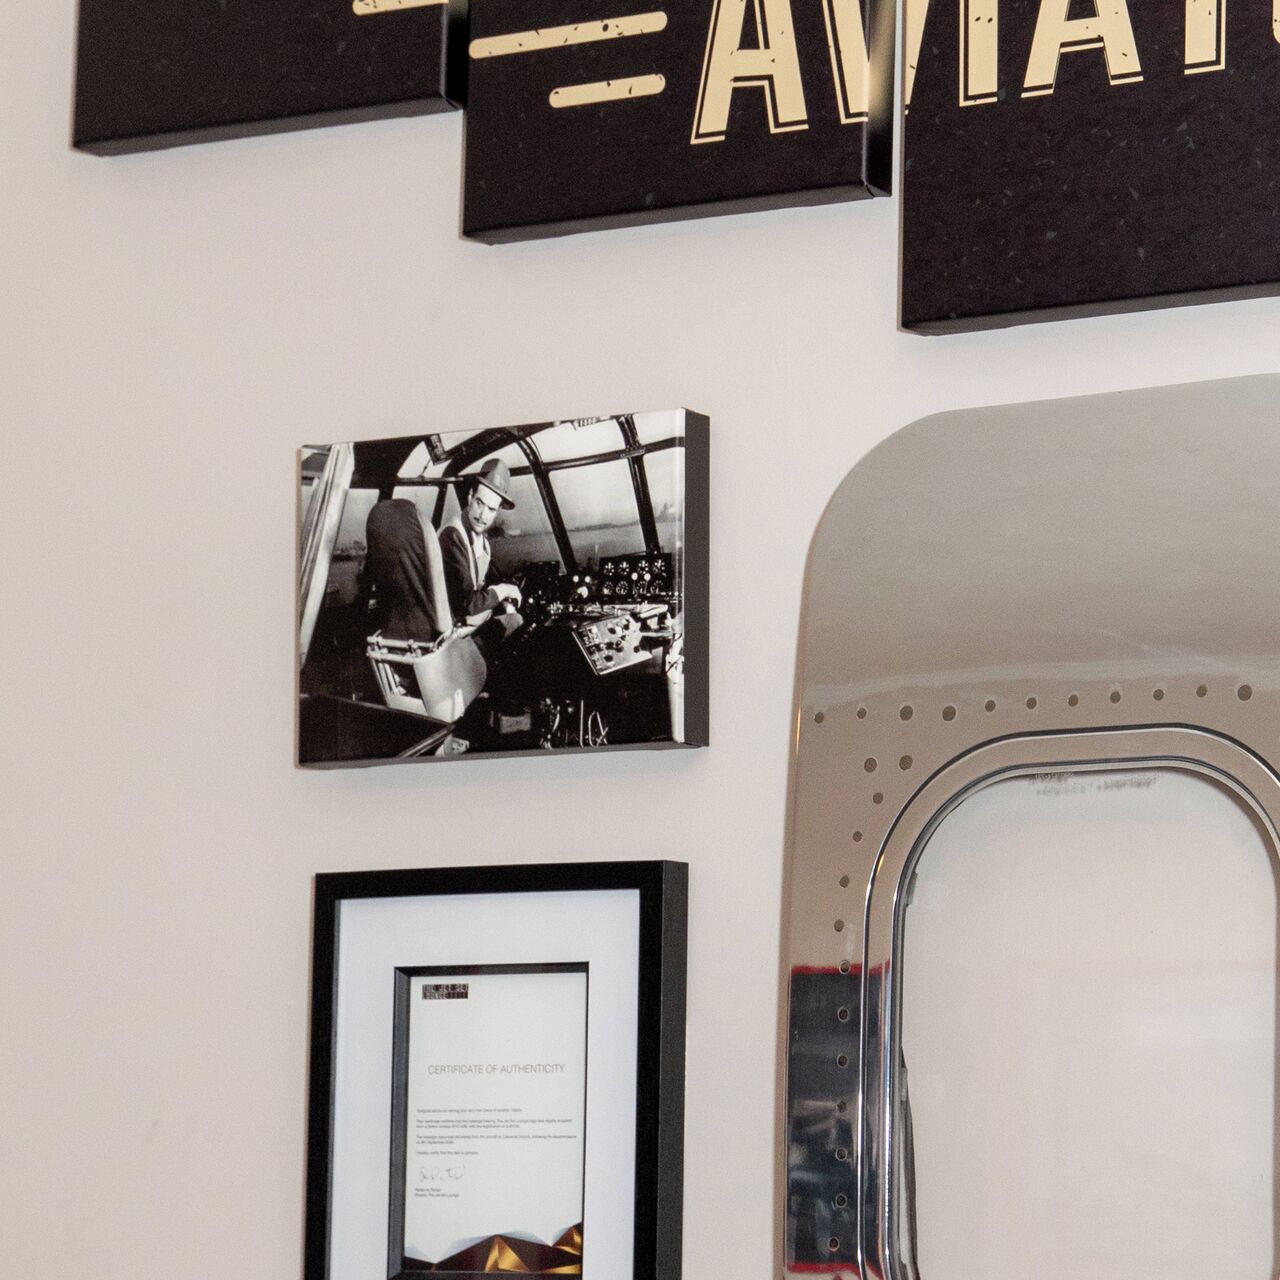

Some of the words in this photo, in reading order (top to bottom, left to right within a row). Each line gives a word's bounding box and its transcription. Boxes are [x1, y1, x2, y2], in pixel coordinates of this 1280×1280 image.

[427, 1064, 484, 1075] CERTIFICATE
[485, 1064, 499, 1074] OF
[500, 1063, 565, 1074] AUTHENTICITY
